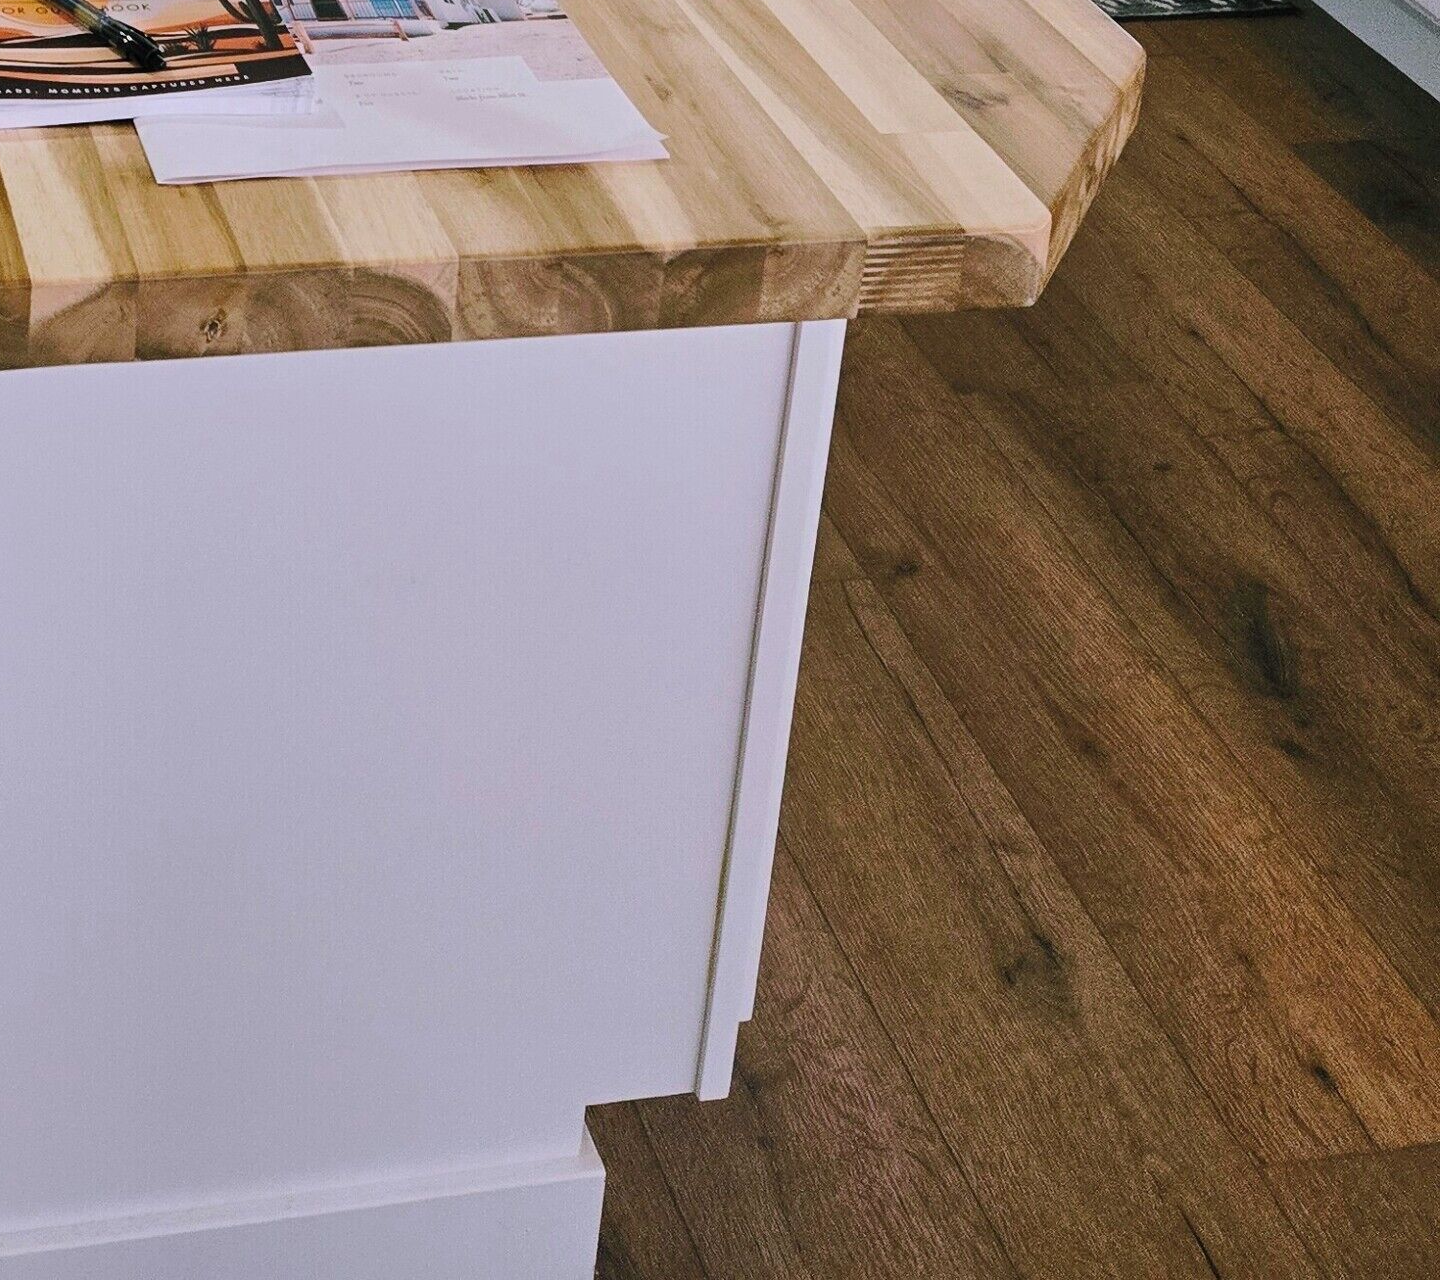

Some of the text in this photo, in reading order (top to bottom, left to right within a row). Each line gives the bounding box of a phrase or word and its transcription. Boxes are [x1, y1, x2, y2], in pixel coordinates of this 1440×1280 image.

[48, 86, 121, 95] MOMENTS
[130, 78, 206, 91] CAPTURED
[215, 74, 250, 83] HERE
